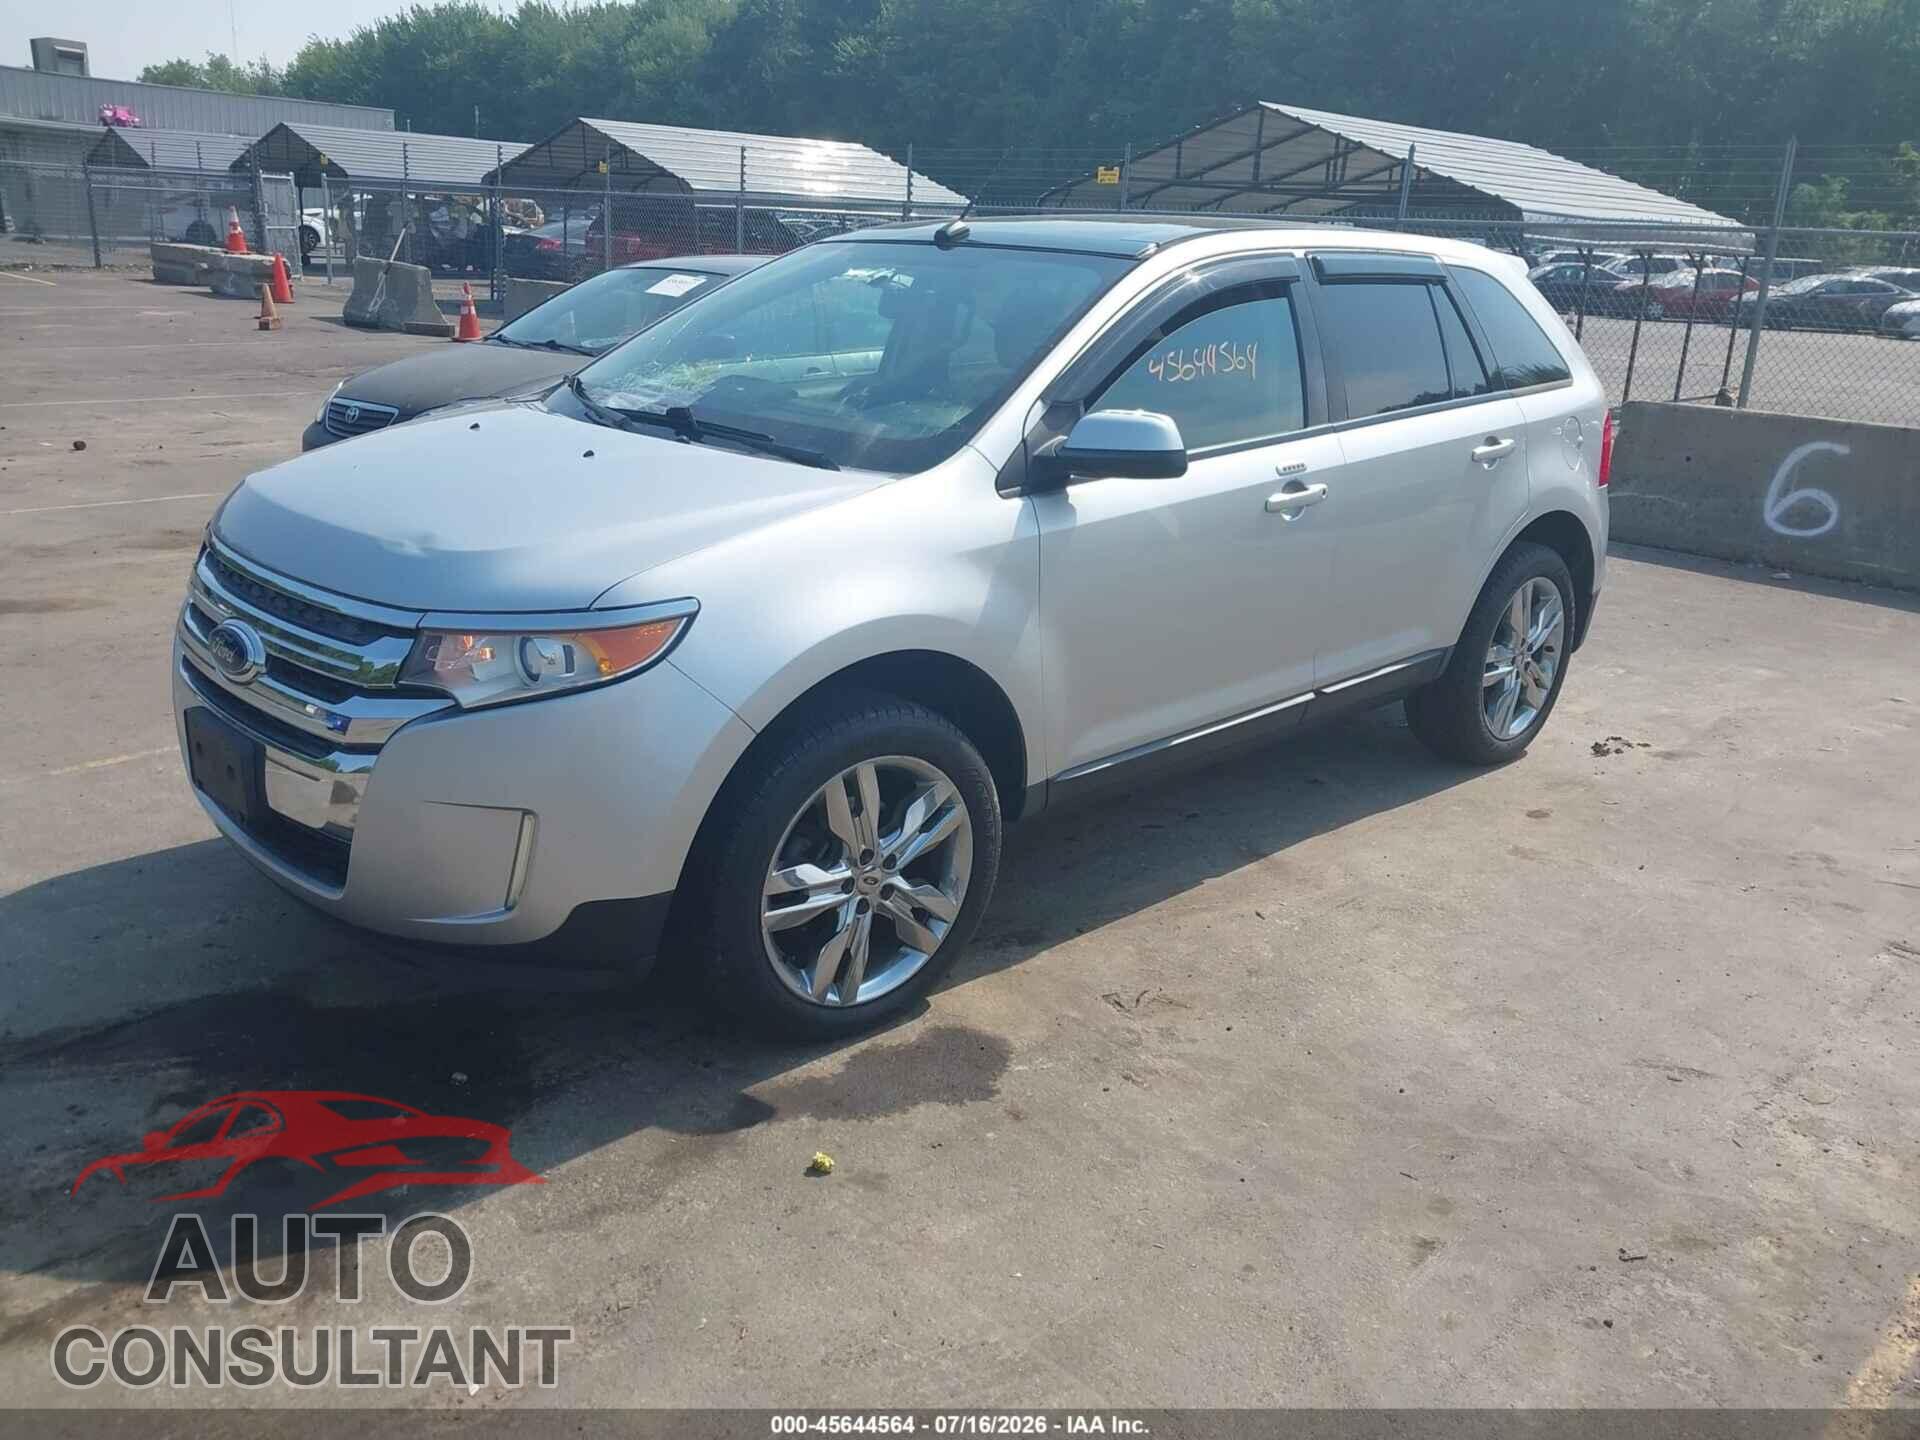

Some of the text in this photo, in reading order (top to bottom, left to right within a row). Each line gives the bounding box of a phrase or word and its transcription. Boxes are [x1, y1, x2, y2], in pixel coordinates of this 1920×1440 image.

[1148, 341, 1258, 382] 45644564
[1764, 441, 1851, 537] 6
[211, 635, 236, 665] Ford
